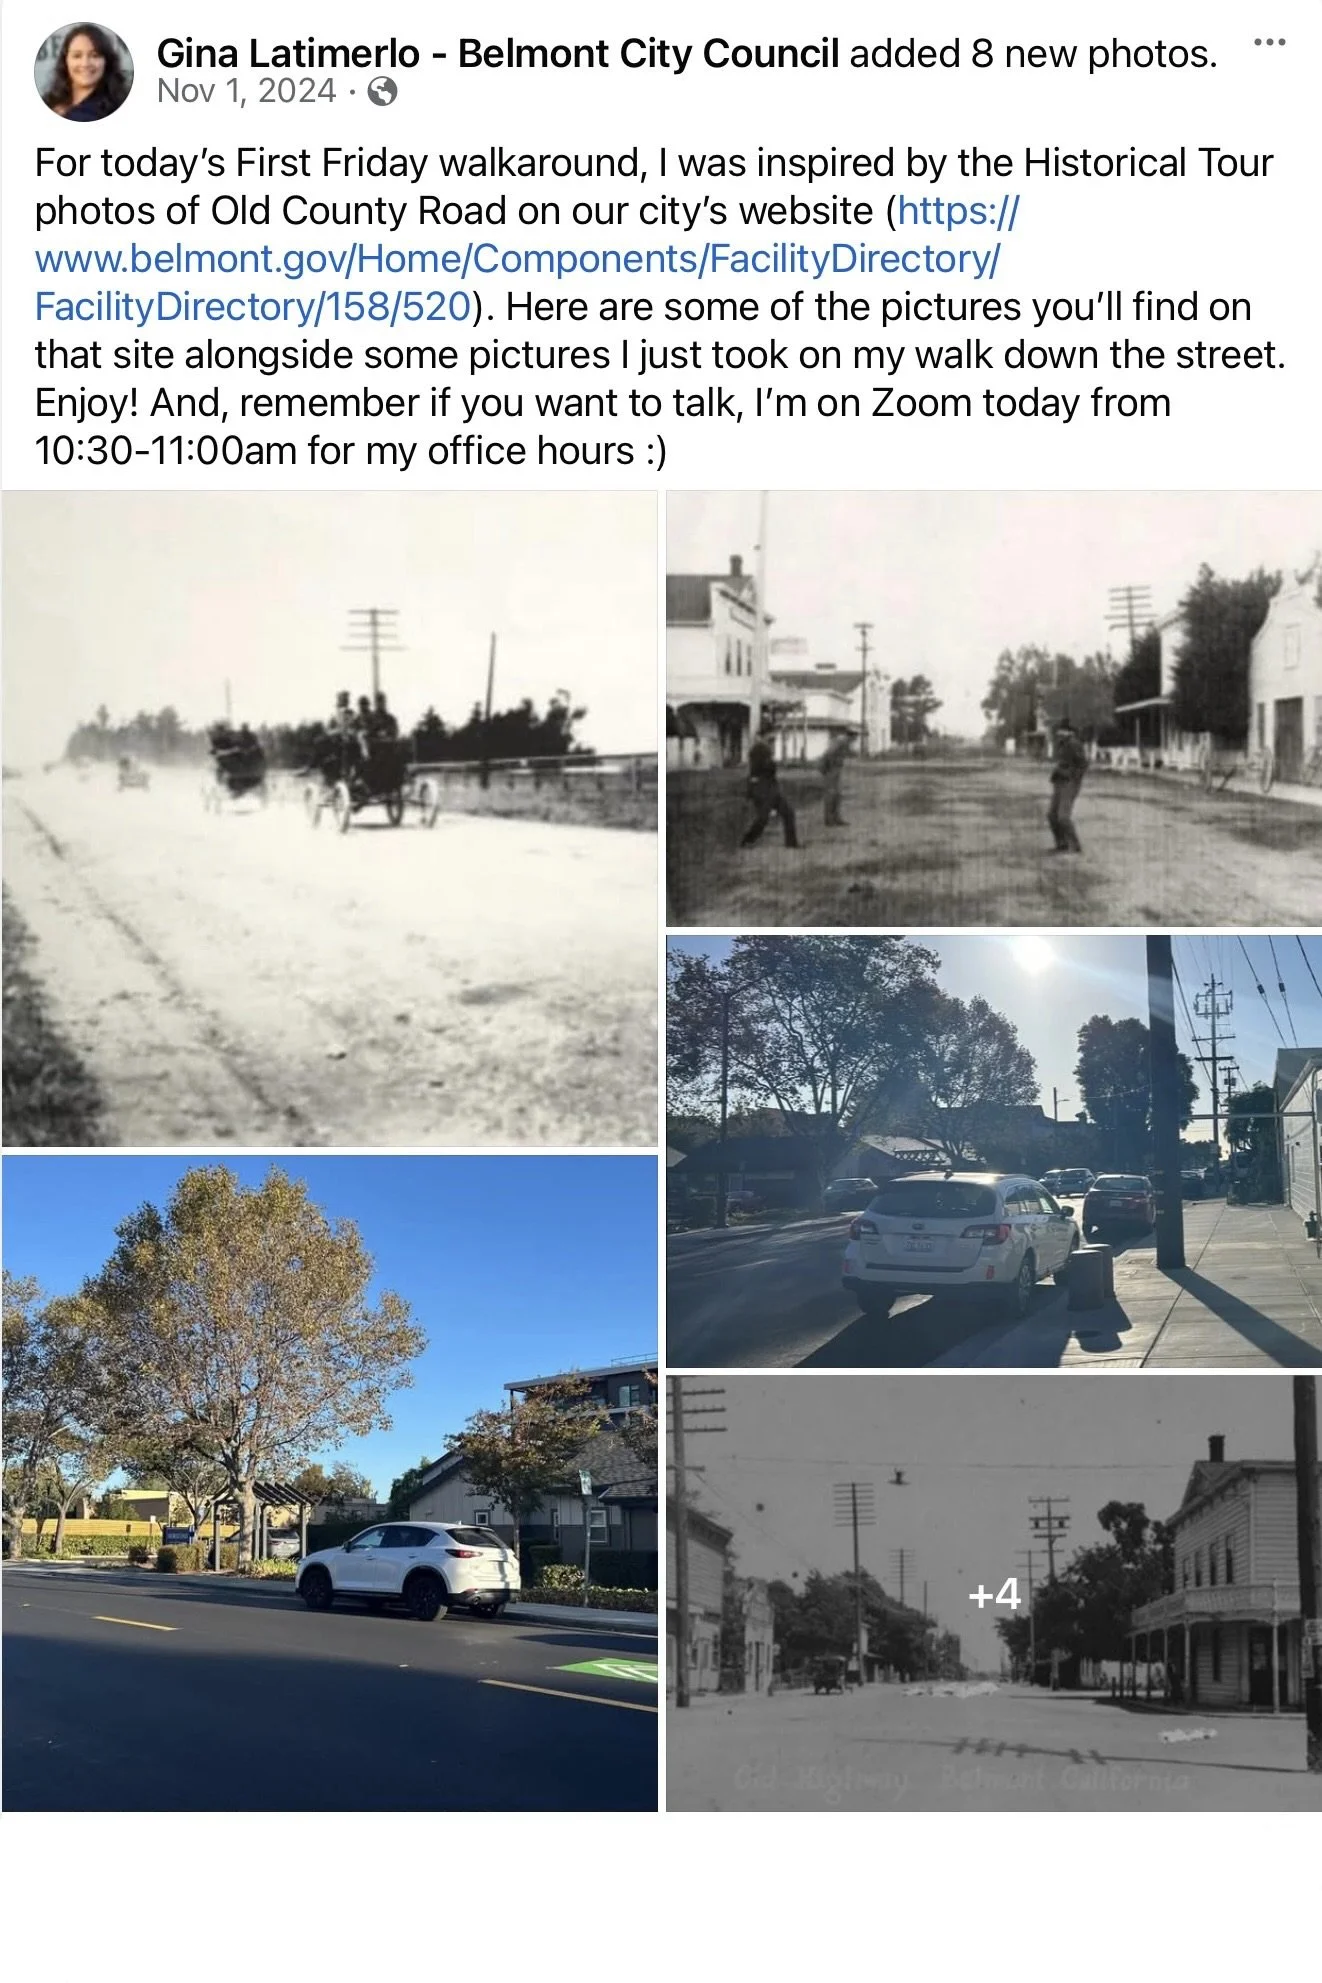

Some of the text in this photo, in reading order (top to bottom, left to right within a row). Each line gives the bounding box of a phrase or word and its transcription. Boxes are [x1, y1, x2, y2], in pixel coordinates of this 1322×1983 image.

[158, 37, 237, 68] Gina
[251, 37, 419, 68] Latimerlo
[460, 38, 609, 68] Belmont
[621, 37, 692, 75] City
[704, 37, 838, 68] Council
[851, 38, 959, 68] added
[972, 38, 993, 68] 8
[1007, 46, 1077, 67] new
[1090, 38, 1216, 74] photos.
[159, 78, 336, 108] Nov 1, 2024
[37, 147, 1274, 183] For today’s First Friday walkaround, I was inspired by the Historical Tour
[37, 194, 1020, 231] photos of Old County Road on our city’s website (https://
[35, 243, 1001, 279] www.belmont.gov/Home/Components/FacilityDirectory/
[37, 291, 1250, 327] FacilityDirectory/158/520). Here are some of the pictures you’ll find on
[35, 339, 1284, 375] that site alongside some pictures I just took on my walk down the street.
[37, 386, 1170, 423] Enjoy! And, remember if you want to talk, I’m on Zoom today from
[36, 434, 665, 471] 10:30-11:00am for my office hours :)
[941, 1763, 1047, 1791] Belmont
[1060, 1764, 1191, 1792] California
